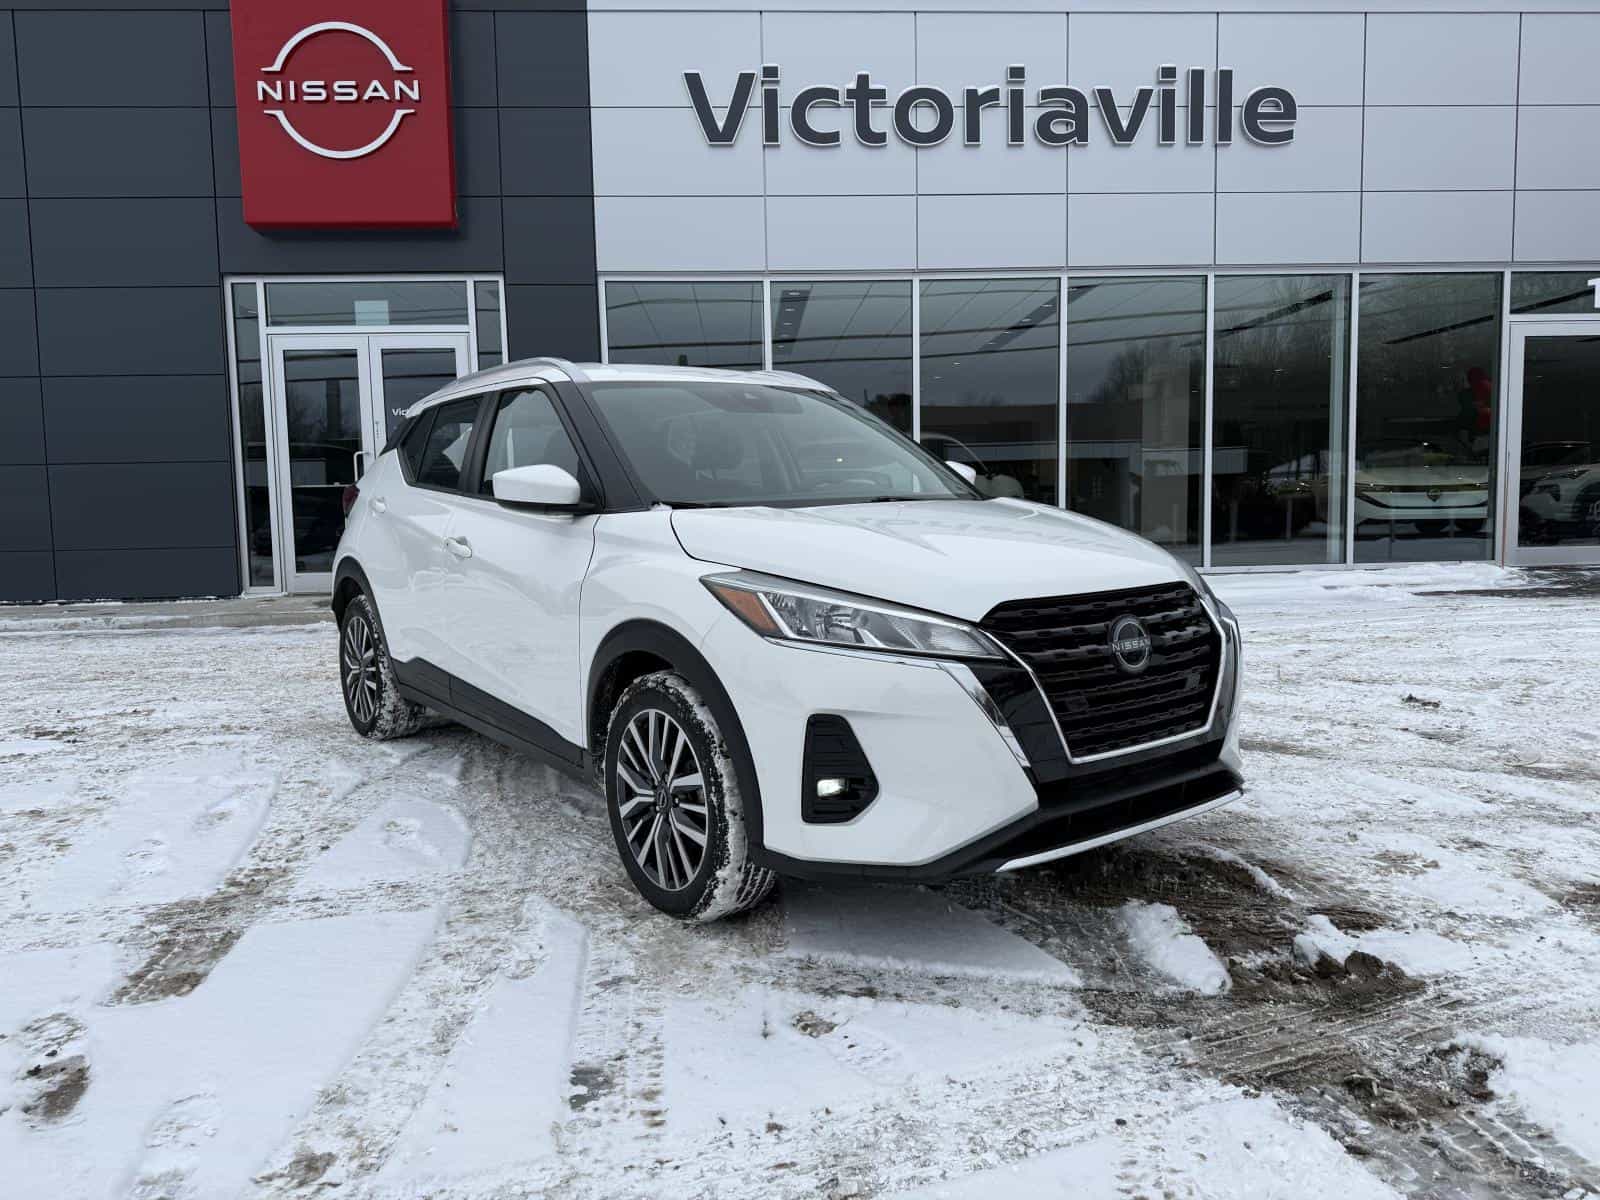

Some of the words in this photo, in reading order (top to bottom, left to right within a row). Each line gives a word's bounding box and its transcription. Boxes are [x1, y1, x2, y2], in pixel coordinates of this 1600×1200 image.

[256, 79, 420, 102] NISSAN
[683, 65, 1298, 147] Victoriaville
[1111, 638, 1151, 652] NISSAN
